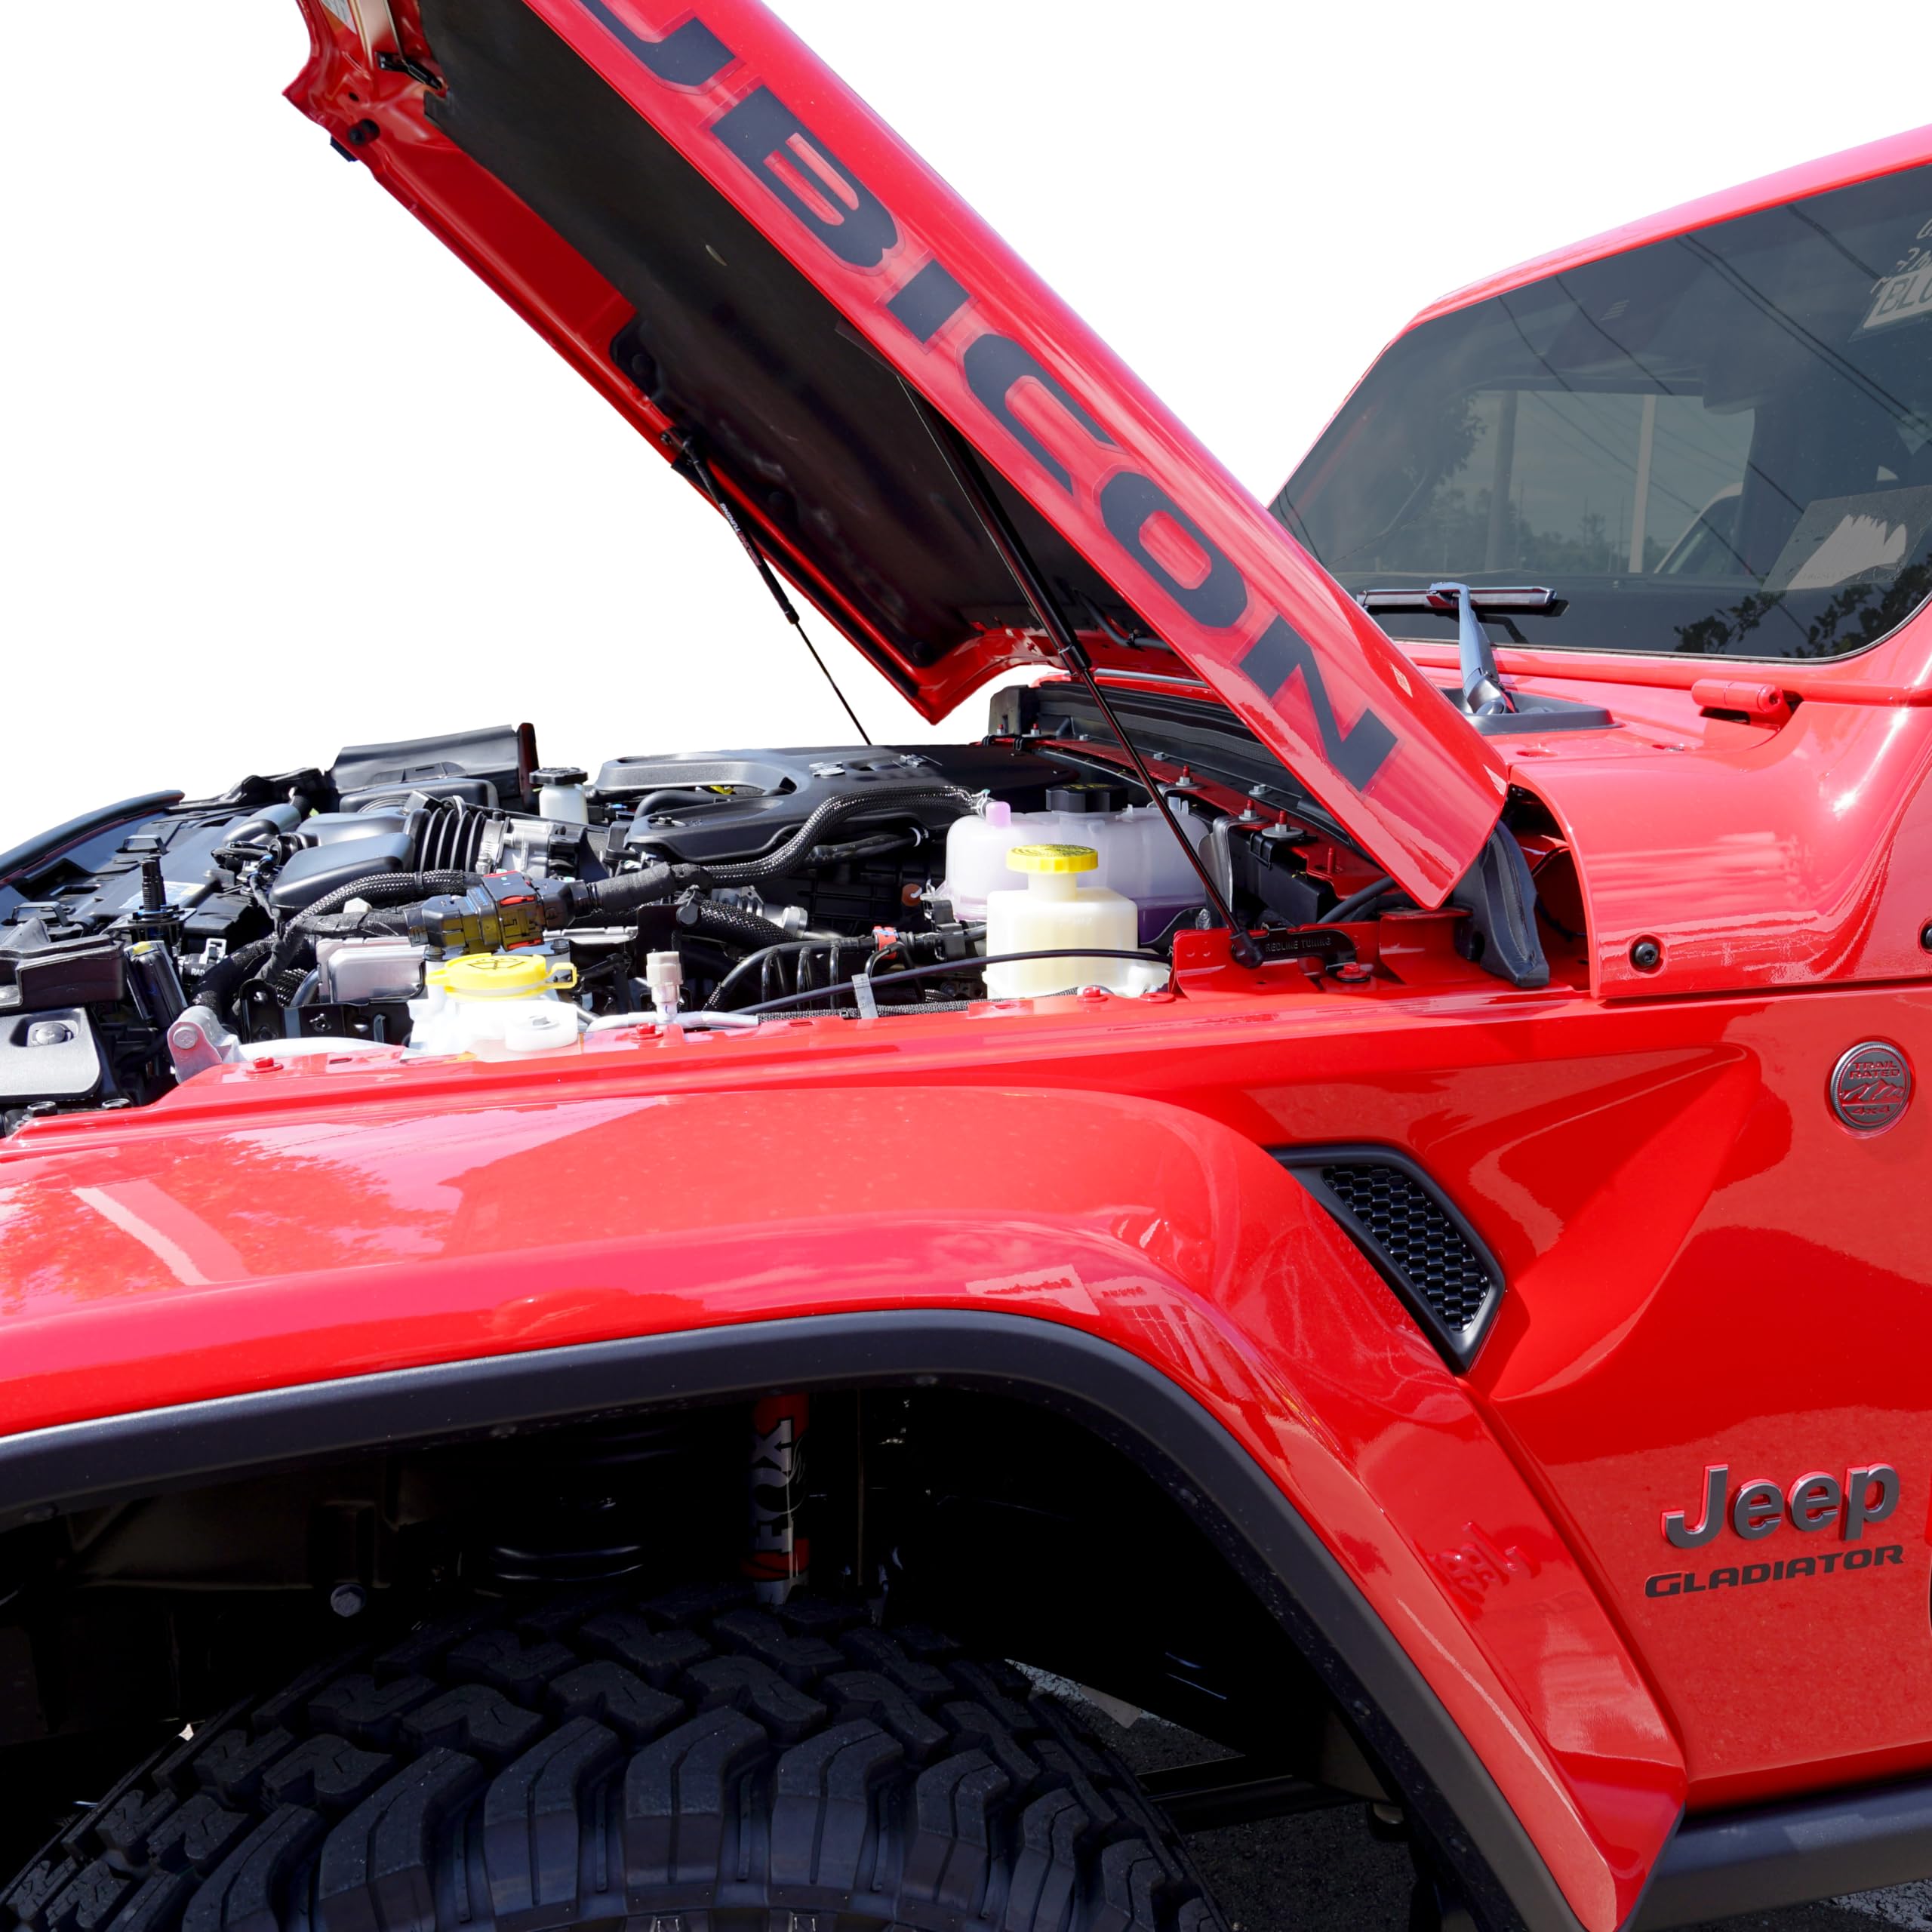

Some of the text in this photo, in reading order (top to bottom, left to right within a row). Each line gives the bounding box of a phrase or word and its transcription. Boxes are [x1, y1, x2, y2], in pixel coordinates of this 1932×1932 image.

[719, 503, 740, 533] TUNING
[1266, 938, 1331, 952] REDLINE TUNING
[1850, 1069, 1900, 1079] RATED
[1854, 1060, 1897, 1070] TRAIL
[751, 1419, 794, 1553] FOX
[1661, 1463, 1900, 1549] Jeep
[1644, 1544, 1905, 1598] GLADIATOR
